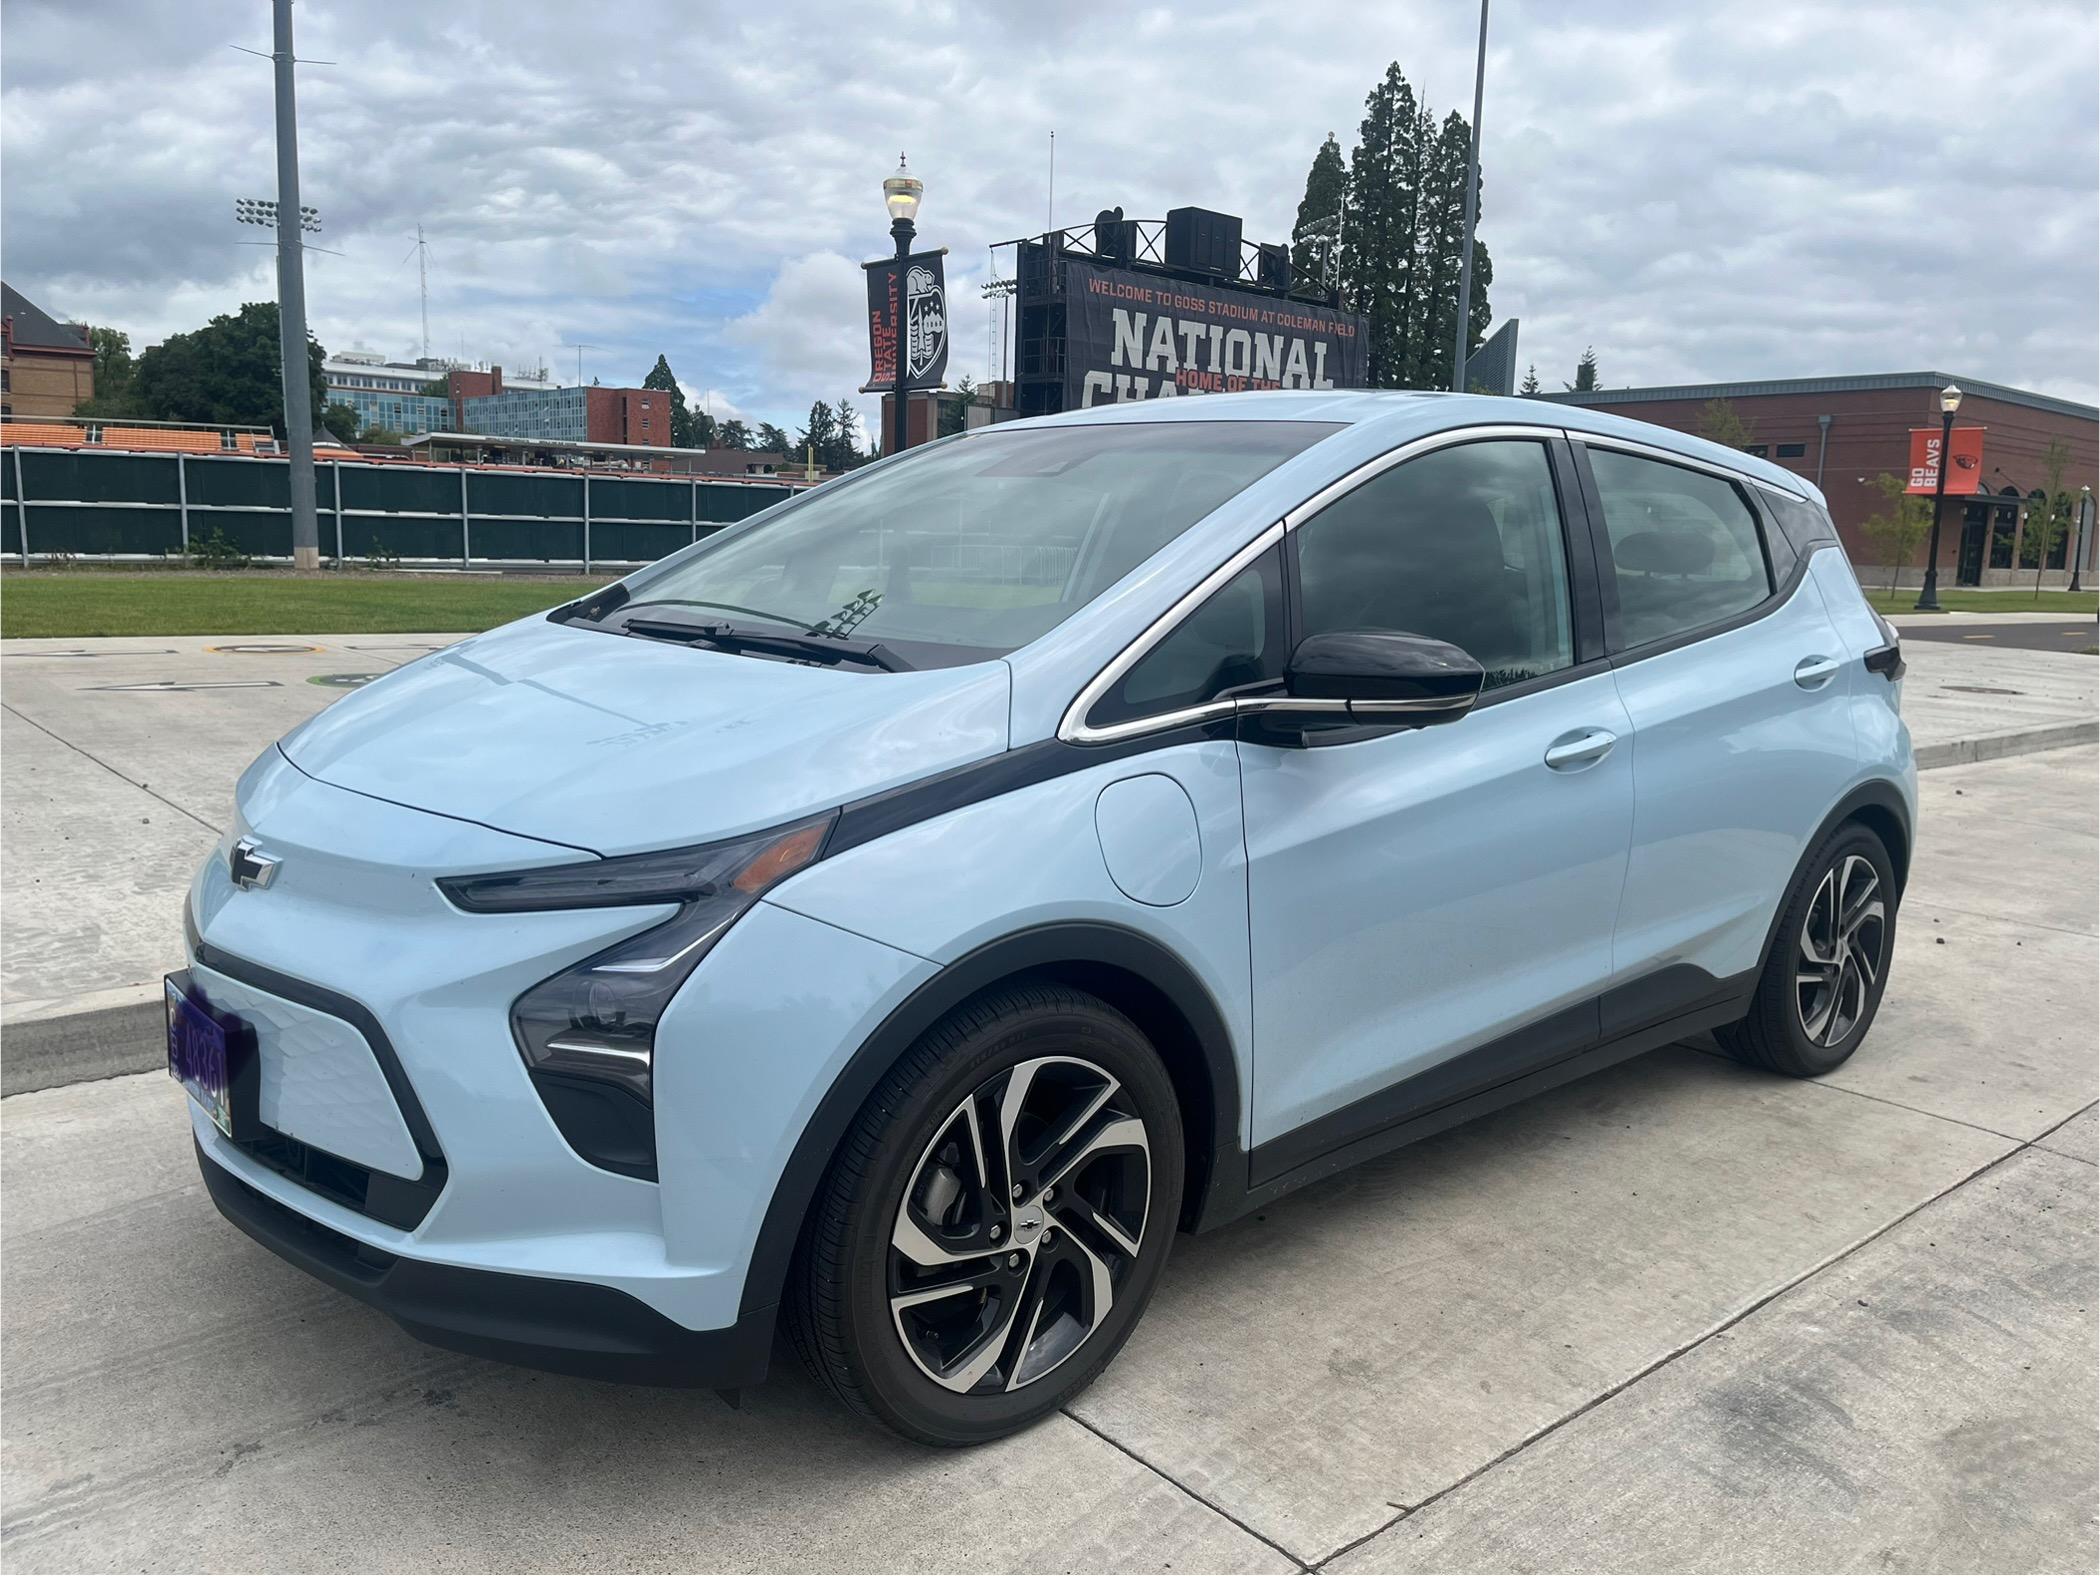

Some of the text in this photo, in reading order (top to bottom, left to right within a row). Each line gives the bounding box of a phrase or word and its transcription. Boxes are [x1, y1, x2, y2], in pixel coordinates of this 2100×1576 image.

[1089, 278, 1355, 337] WELCOME TO GOSS STADIUM AT COLEMAN FIELD
[872, 310, 883, 383] OREGON
[881, 326, 891, 382] STATE
[1111, 308, 1334, 390] NATIONAL
[1175, 368, 1222, 391] HOME
[1227, 375, 1248, 392] OF
[1910, 467, 1925, 487] GO
[1923, 439, 1940, 487] BEAVS
